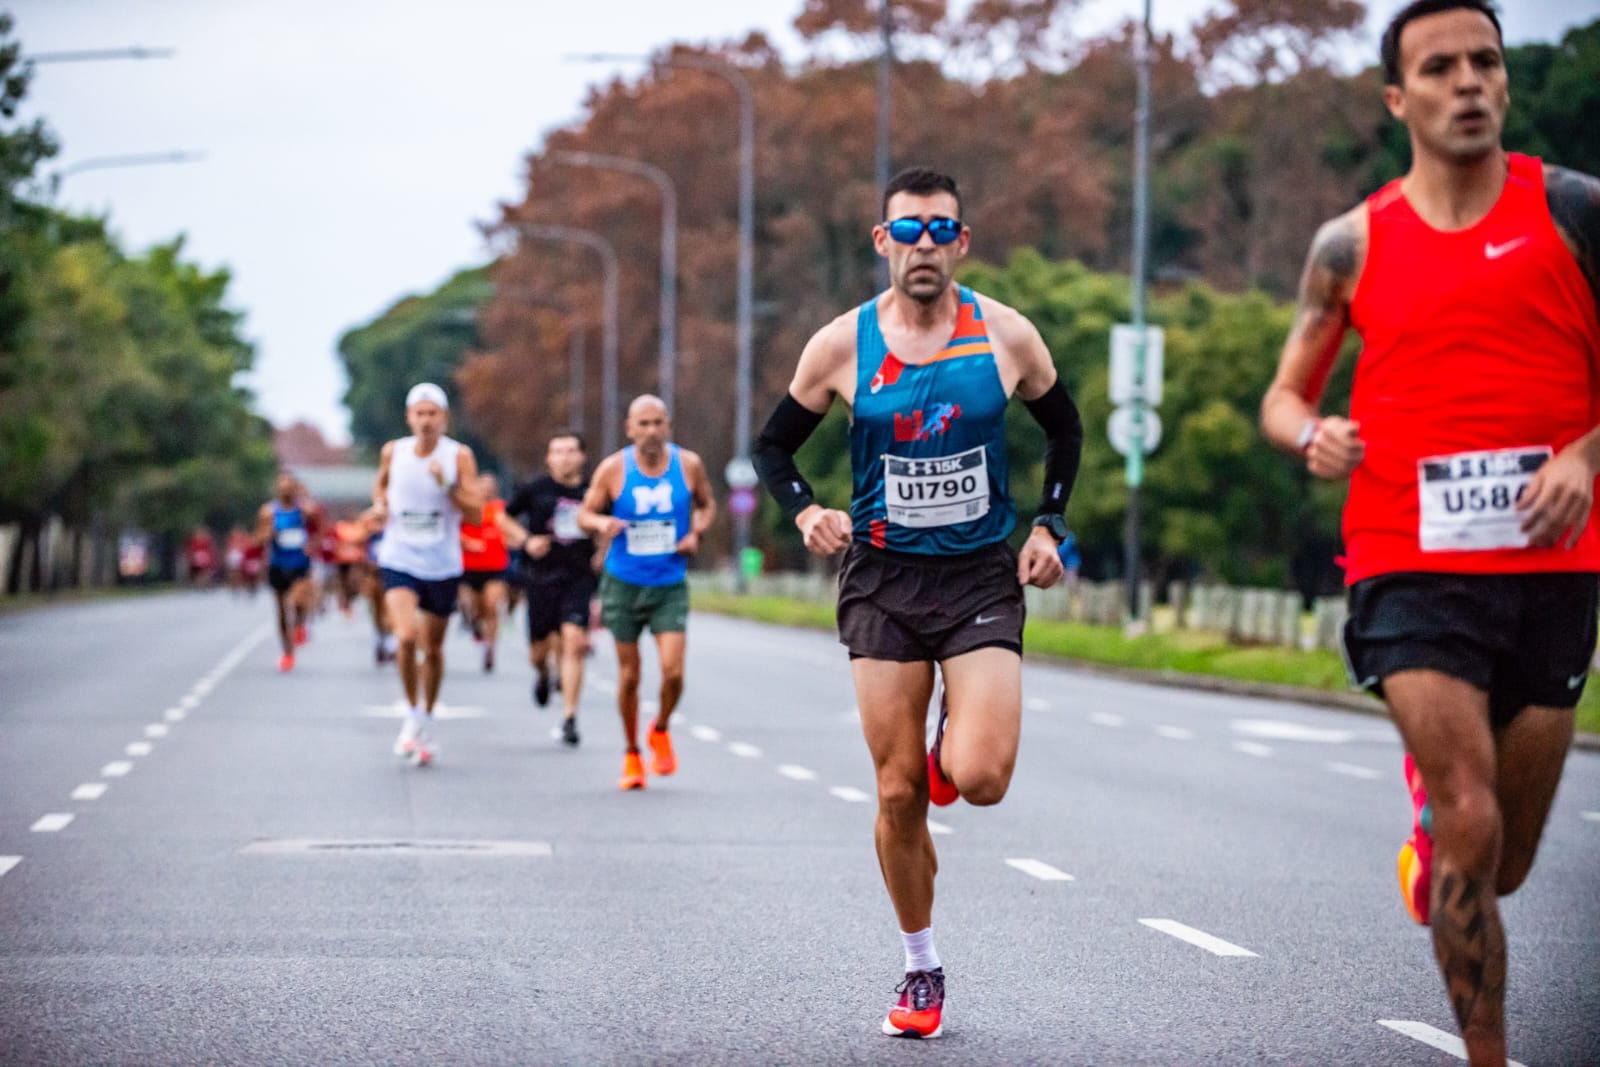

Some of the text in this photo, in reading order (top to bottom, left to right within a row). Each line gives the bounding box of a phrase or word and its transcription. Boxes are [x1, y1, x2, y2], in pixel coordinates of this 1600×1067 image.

[936, 458, 963, 474] 15K
[633, 480, 674, 514] M
[898, 475, 976, 500] U1790
